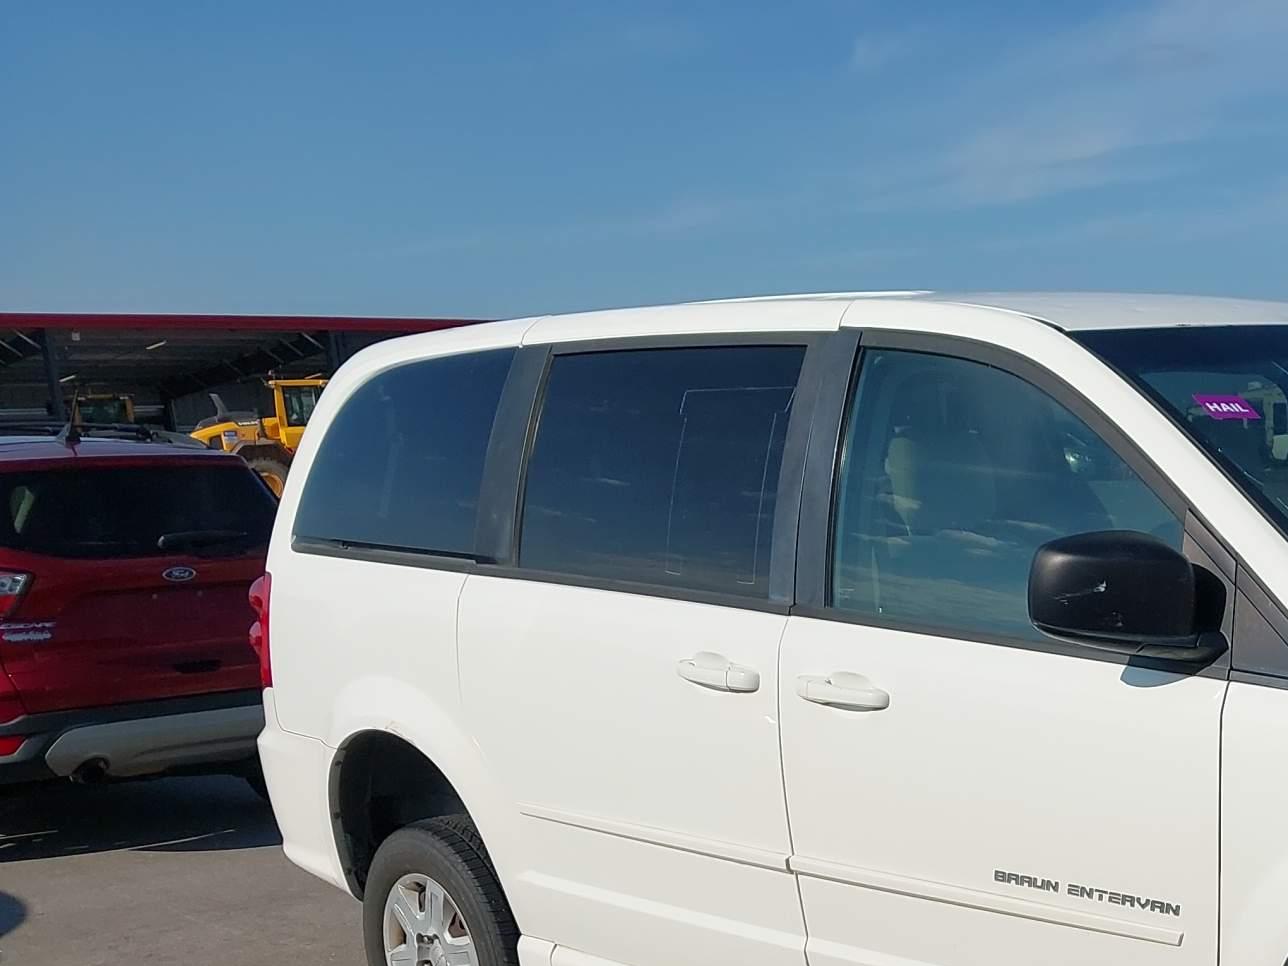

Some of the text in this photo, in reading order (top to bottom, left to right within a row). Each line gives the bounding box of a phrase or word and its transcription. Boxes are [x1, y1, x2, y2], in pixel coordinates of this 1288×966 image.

[1205, 402, 1250, 413] HAIL
[994, 869, 1181, 917] BRAUN ENTERVAN
